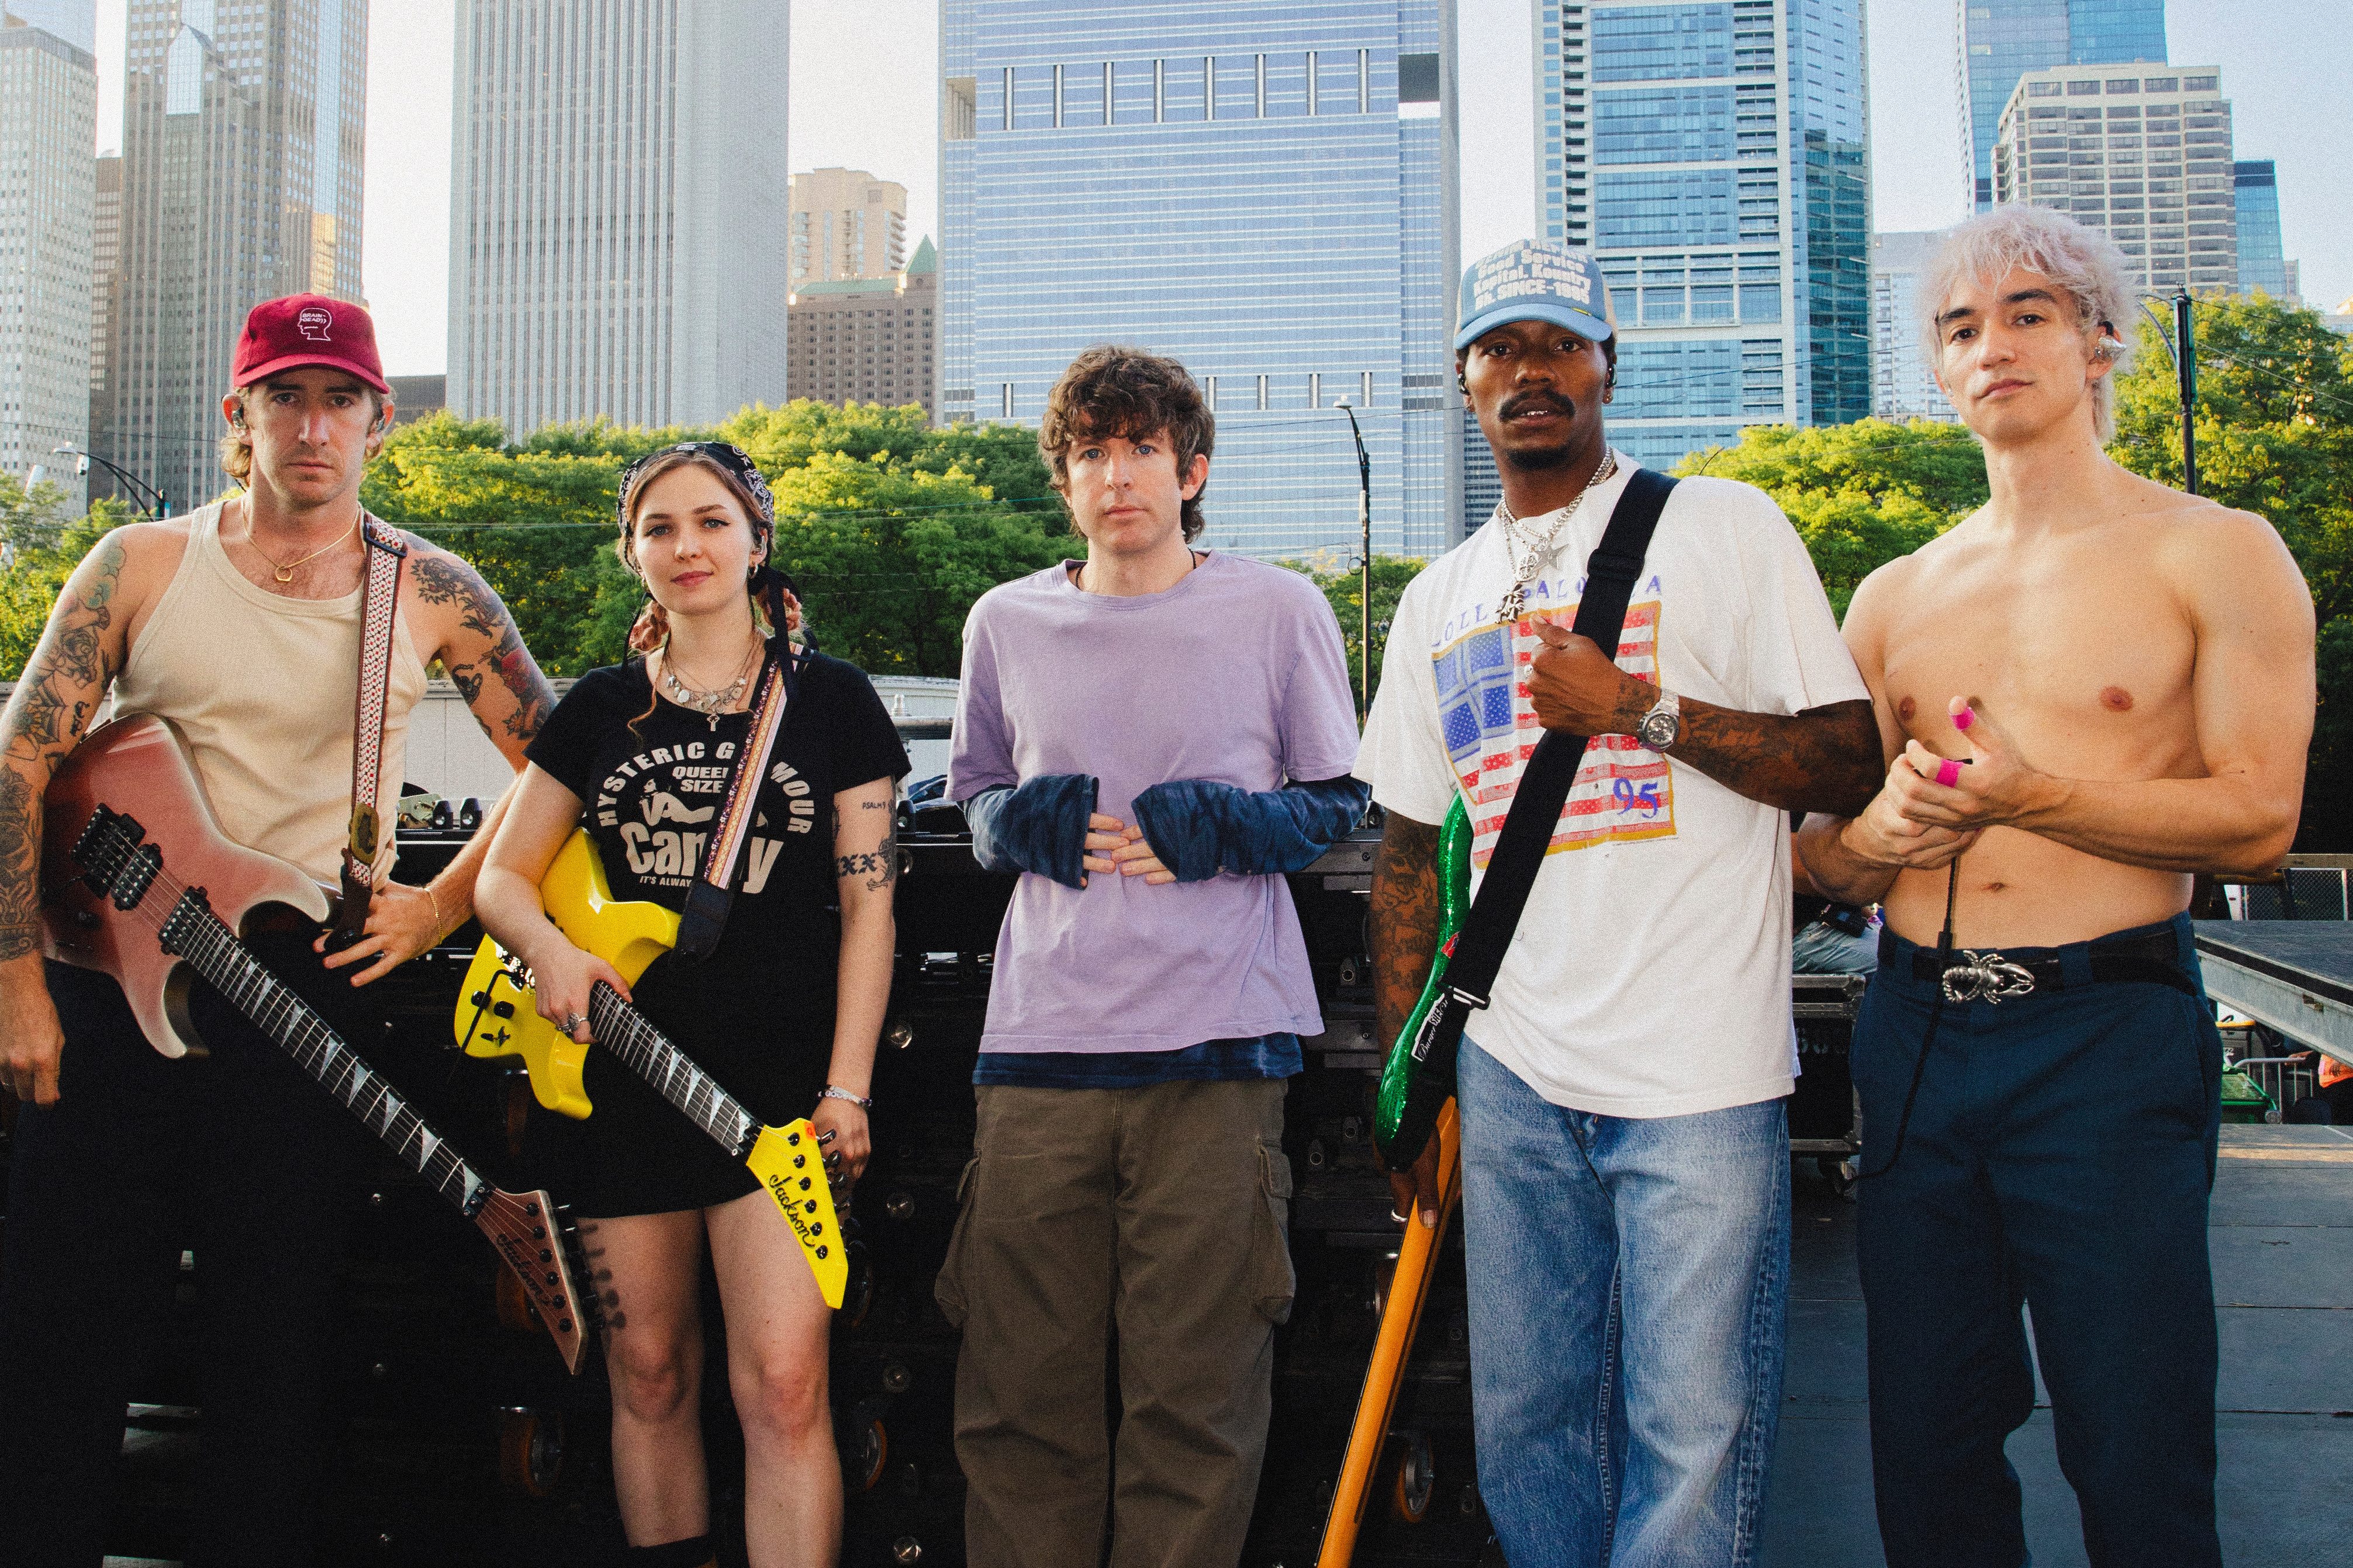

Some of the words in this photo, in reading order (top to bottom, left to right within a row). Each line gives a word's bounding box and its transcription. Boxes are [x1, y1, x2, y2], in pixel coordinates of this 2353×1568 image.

[1477, 254, 1515, 279] Good
[1521, 249, 1585, 274] Service
[1532, 264, 1591, 291] Kountry
[598, 742, 704, 826] HYSTERIC
[716, 742, 815, 834] GMOUR
[680, 779, 724, 794] SIZE
[1613, 777, 1658, 818] 95
[620, 822, 784, 894] Cany
[640, 876, 657, 885] IT'S
[659, 877, 693, 887] ALWAY
[769, 1174, 816, 1248] Jackson
